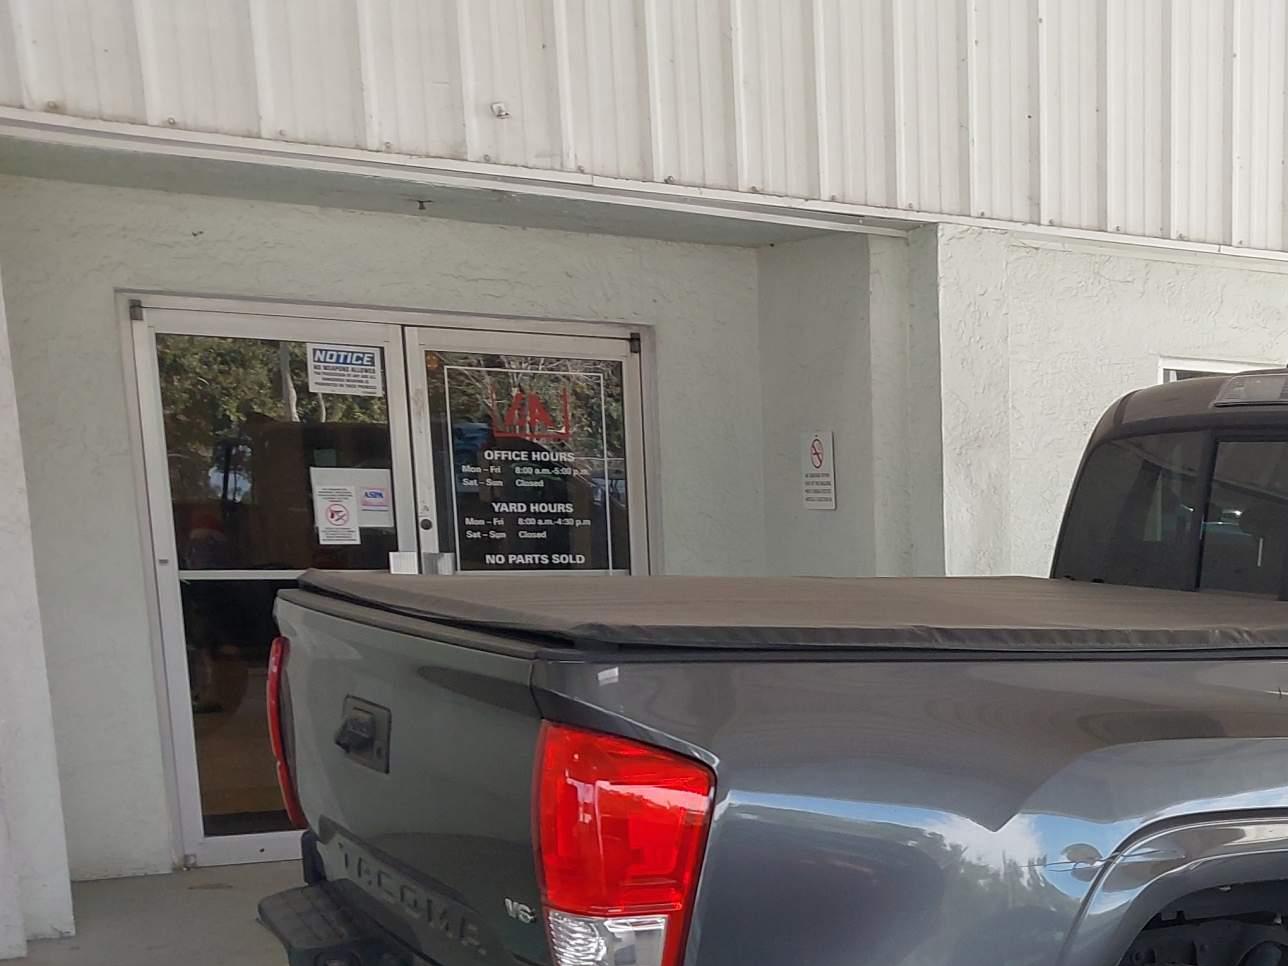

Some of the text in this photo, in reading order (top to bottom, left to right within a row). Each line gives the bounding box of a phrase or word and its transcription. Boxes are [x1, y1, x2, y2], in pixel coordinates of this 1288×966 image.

[314, 350, 374, 365] NOTICE
[484, 450, 575, 462] OFFICE HOURS
[462, 465, 481, 473] Mon
[490, 465, 501, 474] Fri
[463, 478, 478, 486] Sat
[486, 479, 504, 487] Sun
[492, 502, 574, 513] YARD HOURS
[465, 517, 485, 526] Mon
[493, 517, 505, 526] Fri
[466, 530, 481, 539] Sat
[489, 530, 507, 539] Sun
[518, 531, 548, 539] Closed
[485, 554, 585, 565] NO PARTS SOLD
[504, 897, 536, 924] V6
